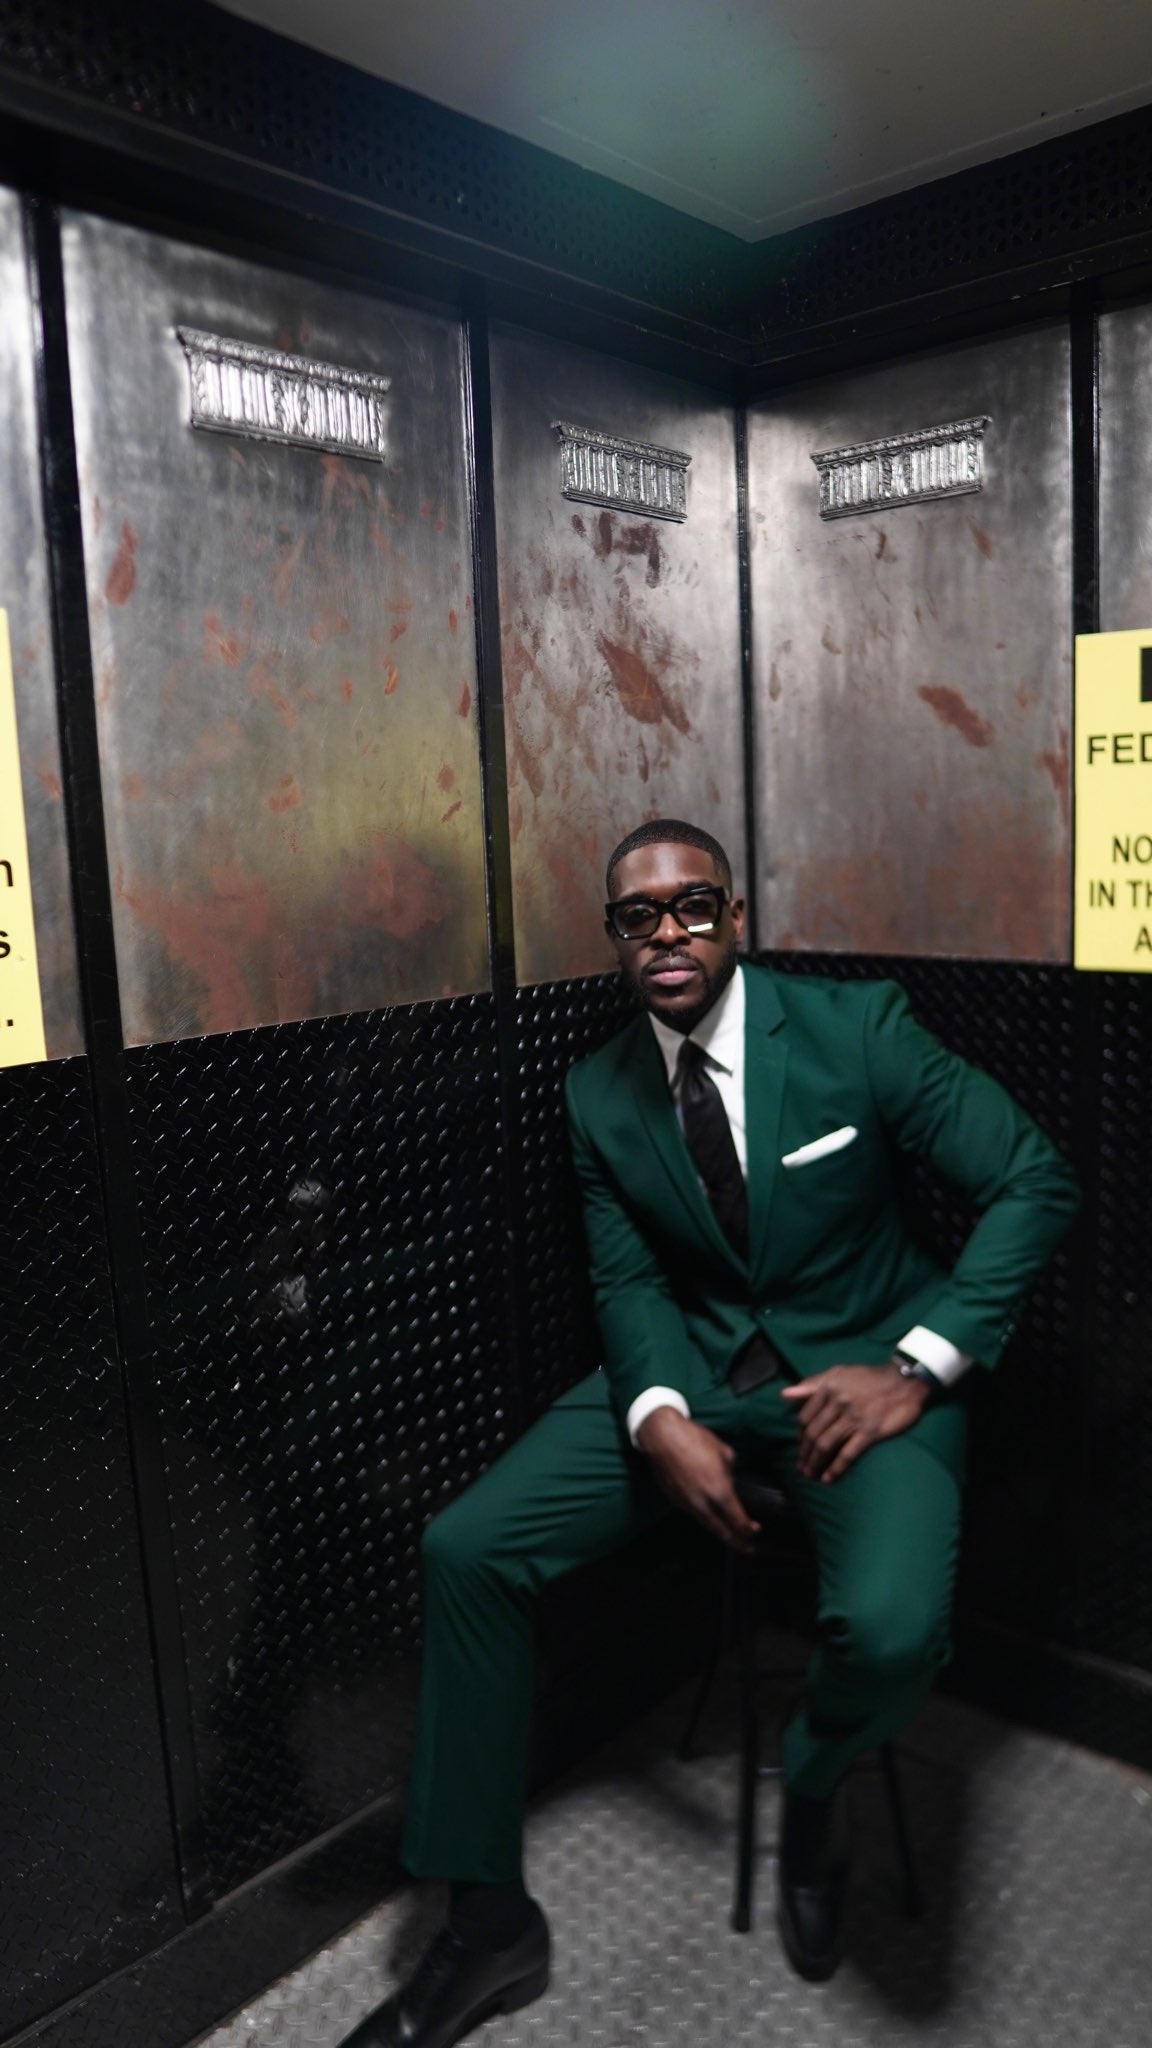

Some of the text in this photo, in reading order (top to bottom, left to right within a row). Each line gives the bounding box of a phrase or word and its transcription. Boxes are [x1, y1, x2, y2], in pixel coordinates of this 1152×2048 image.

[1112, 835, 1152, 864] NO
[1089, 880, 1116, 908] IN
[1134, 926, 1152, 952] A
